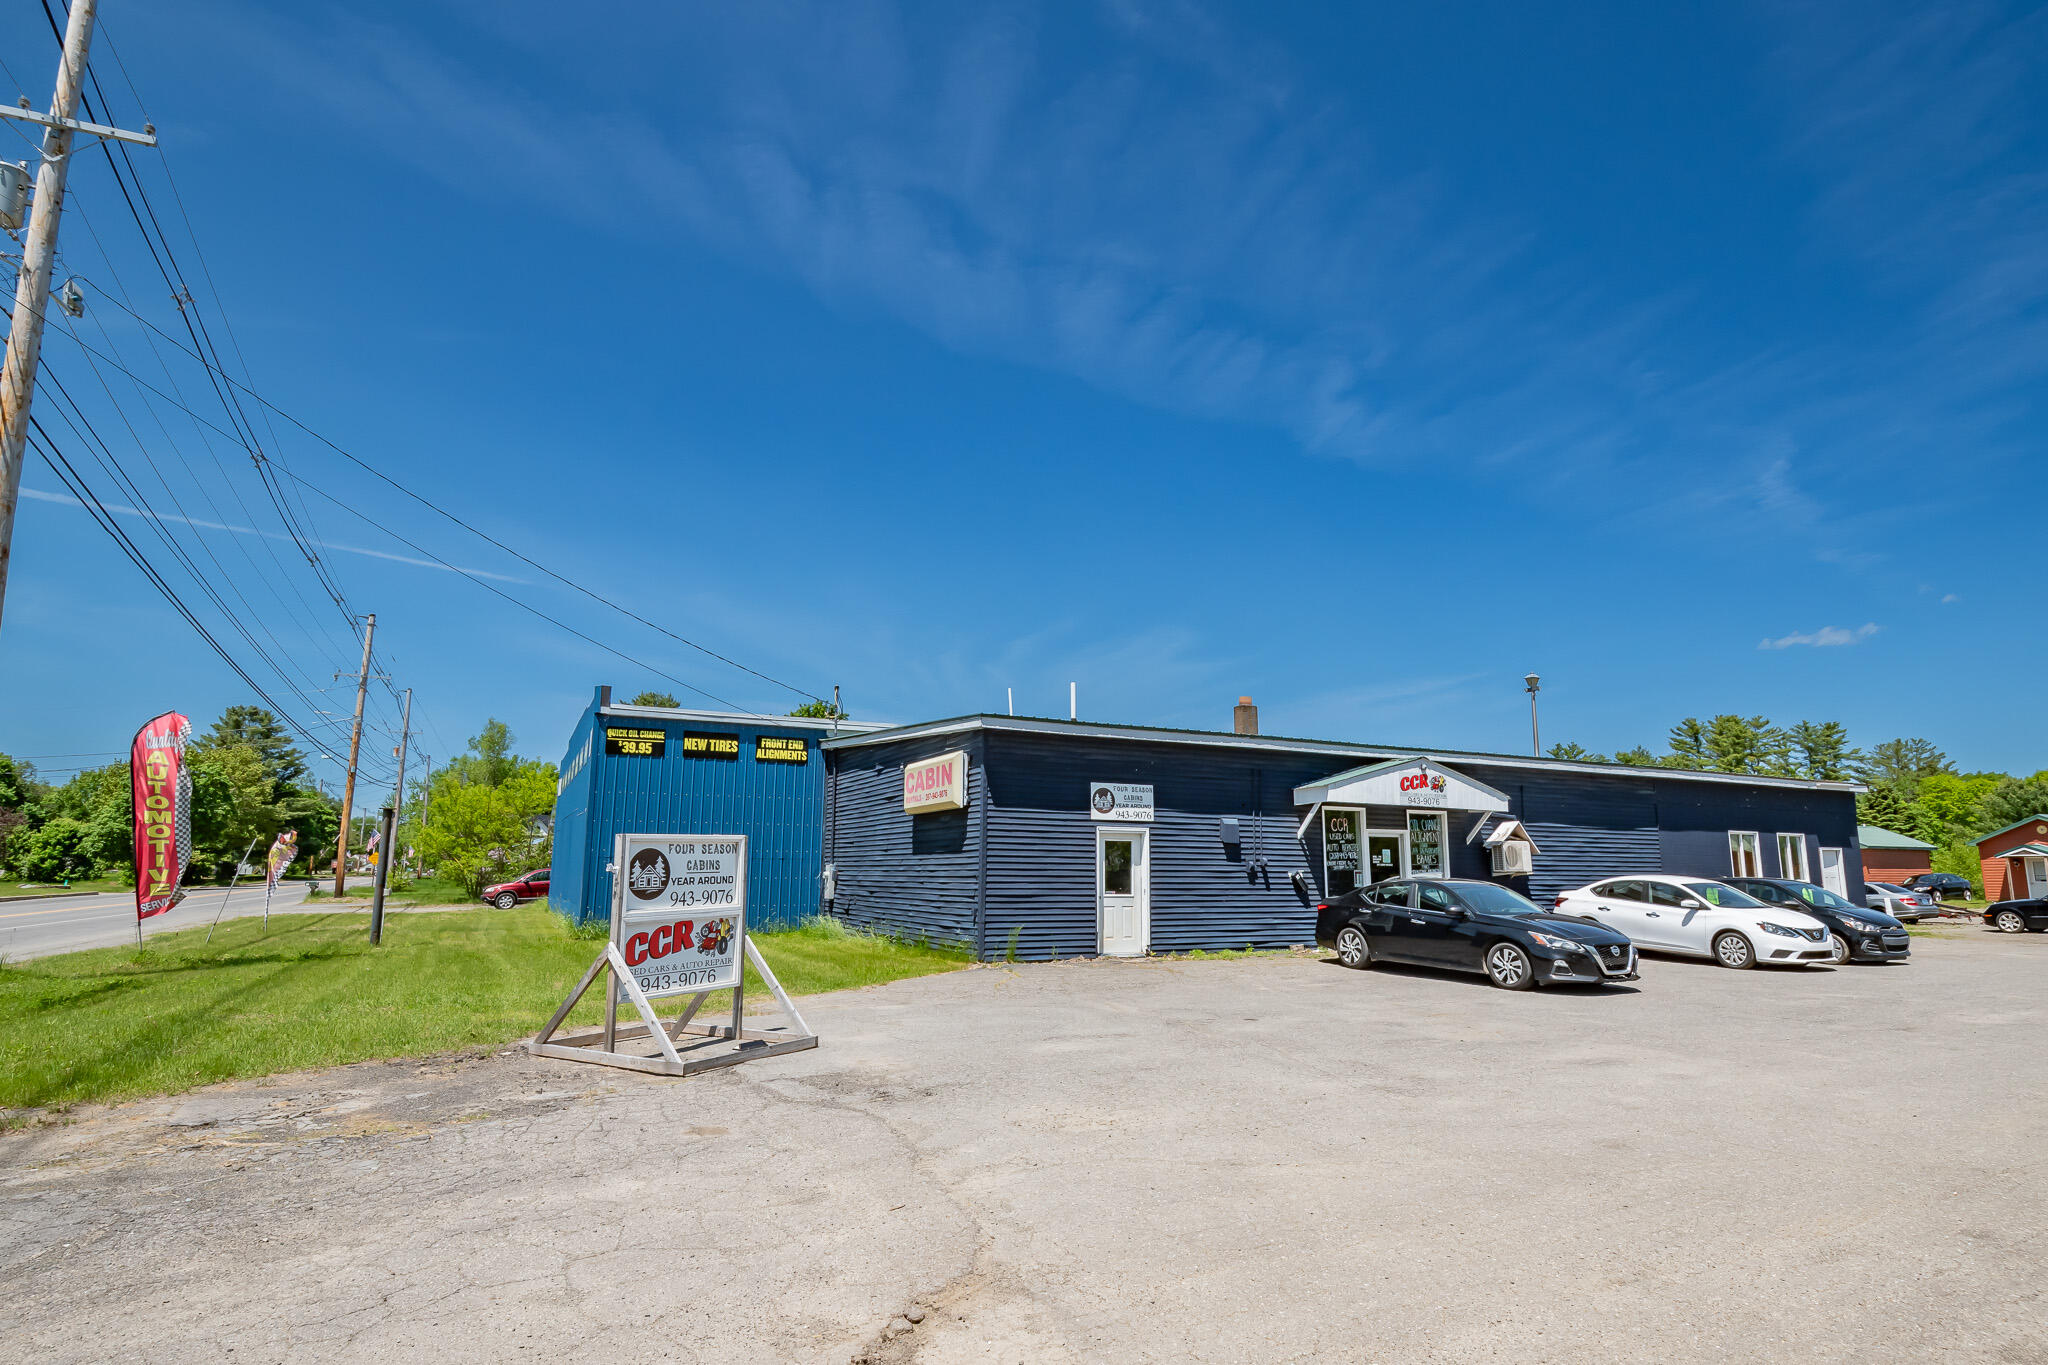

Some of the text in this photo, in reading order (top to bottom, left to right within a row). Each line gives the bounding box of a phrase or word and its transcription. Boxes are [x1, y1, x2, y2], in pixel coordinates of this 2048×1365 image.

[146, 730, 180, 753] Quality
[607, 728, 666, 740] QUICK OIL CHANGE
[618, 740, 653, 755] $39.95
[683, 737, 739, 753] NEW TIRES
[761, 737, 804, 750] FRONT END
[756, 750, 808, 762] ALIGNMENTS
[905, 762, 953, 794] CABIN
[1400, 773, 1429, 792] CCR
[1407, 796, 1441, 806] 943-9076
[1115, 810, 1152, 820] 943-9076
[144, 750, 173, 897] AUTOMOTIVE
[1330, 818, 1349, 833] CCR
[668, 843, 738, 855] FOUR SEASON
[686, 859, 721, 872] CABINS
[670, 875, 734, 886] YEAR AROUND
[670, 889, 733, 907] 943-9076
[625, 919, 694, 967] CCR
[630, 957, 733, 976] SED CARS & AUTO REPAIR
[640, 968, 717, 993] 943-9076
